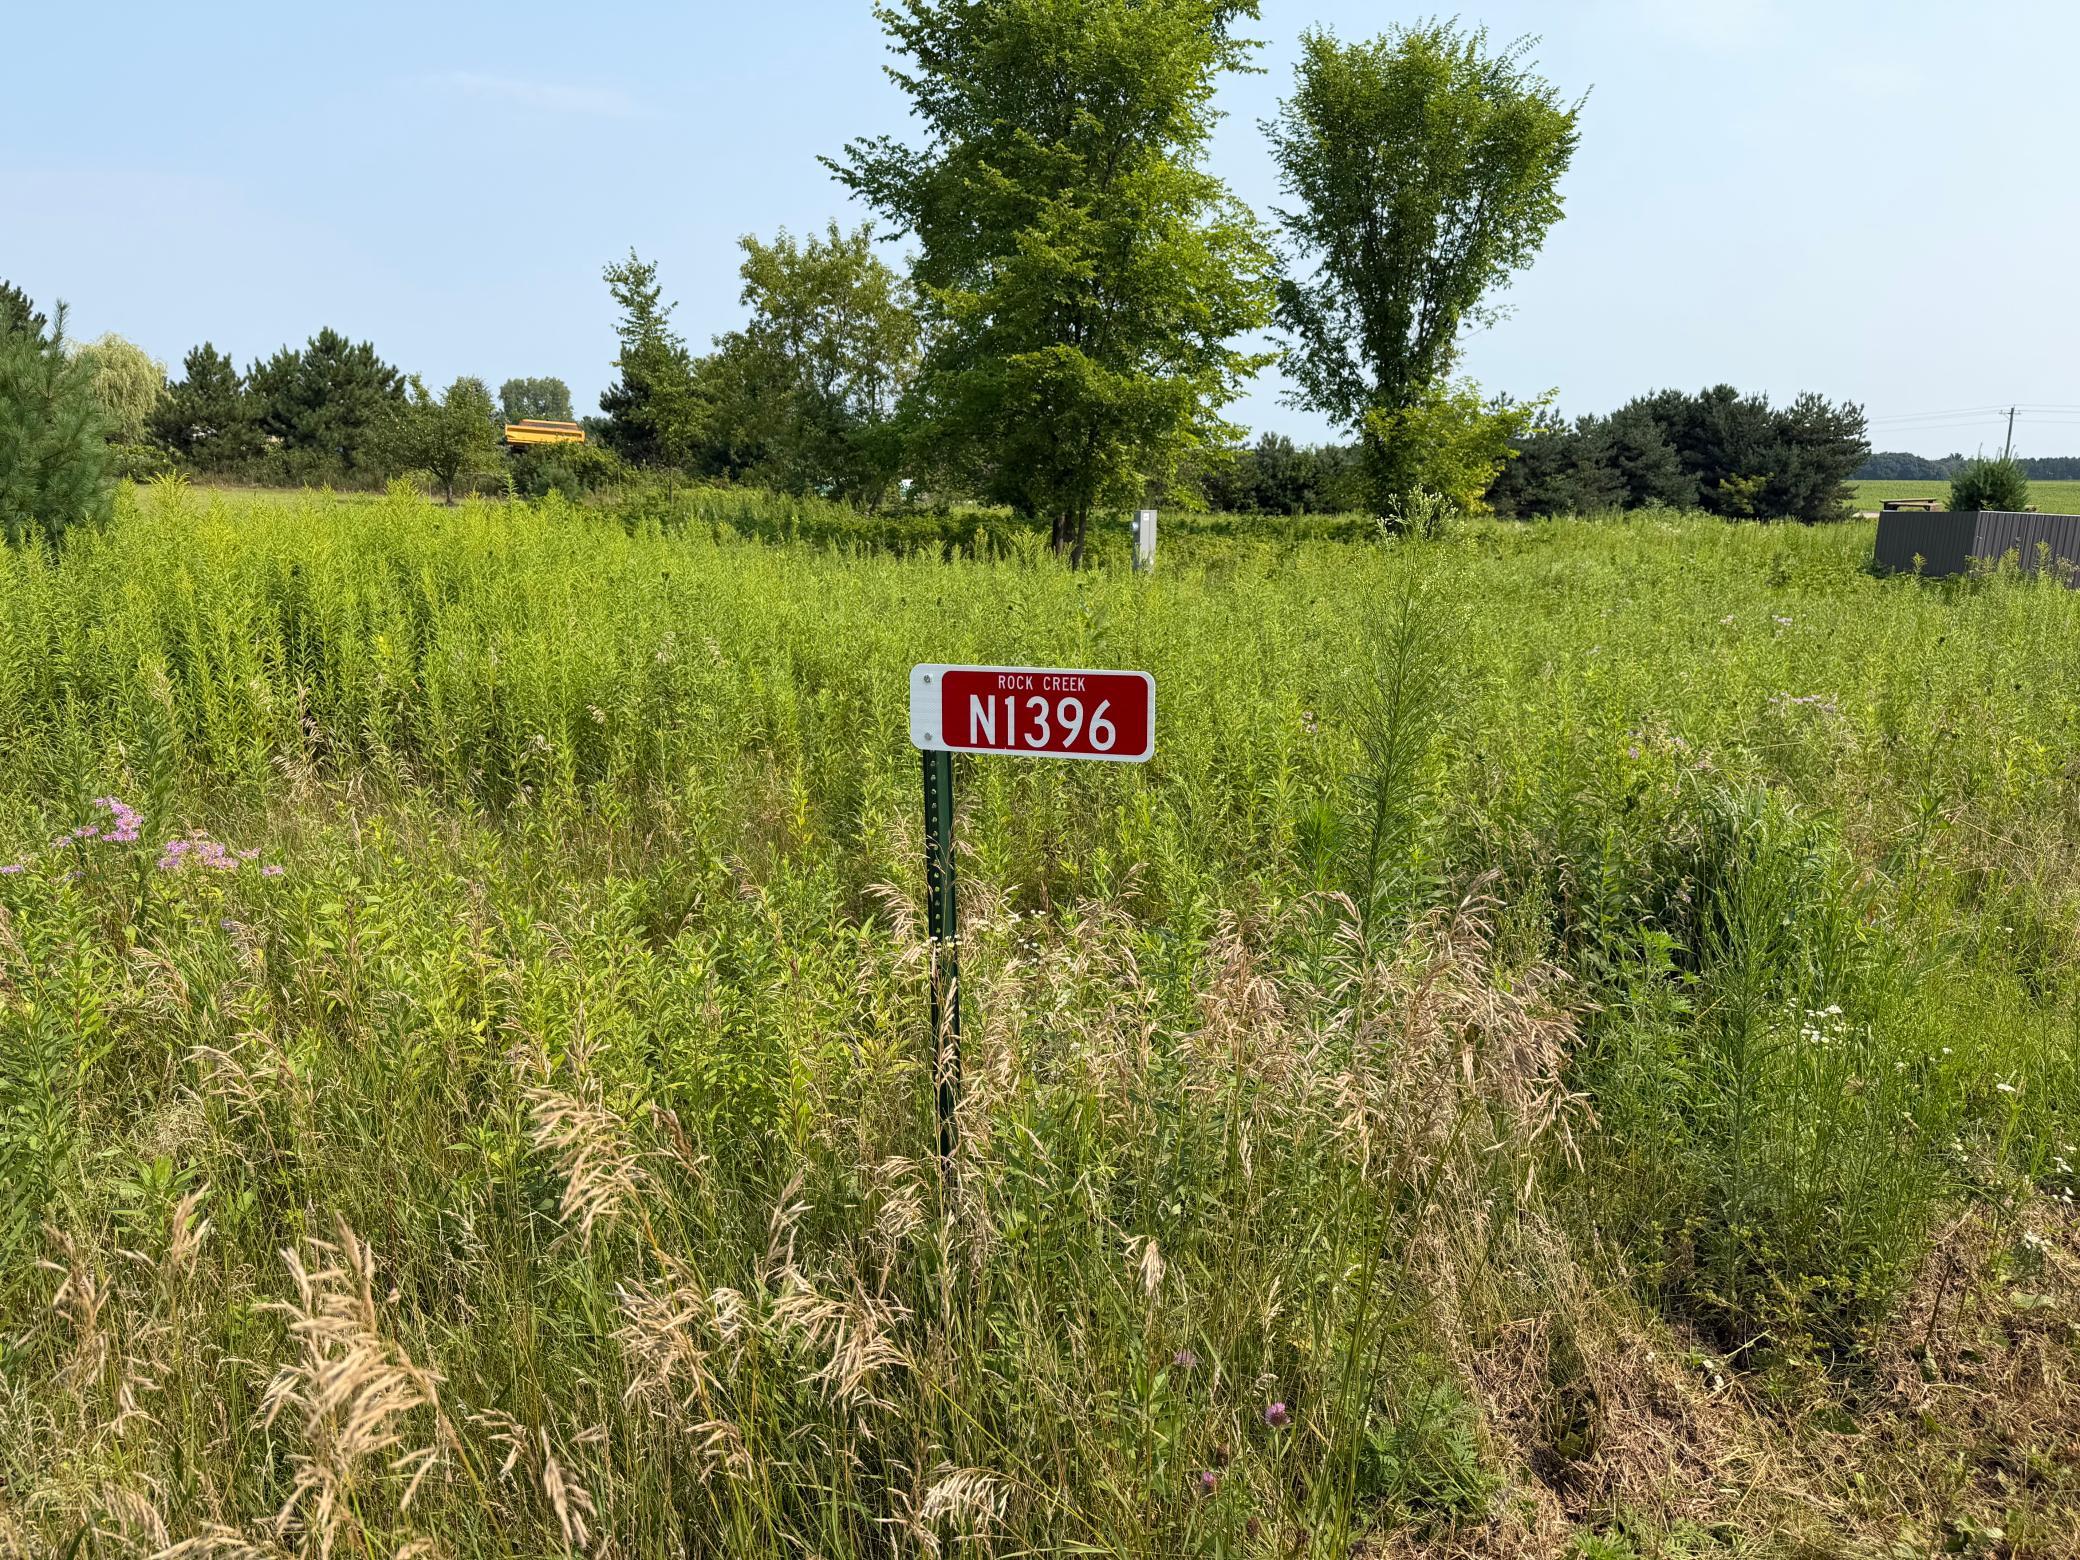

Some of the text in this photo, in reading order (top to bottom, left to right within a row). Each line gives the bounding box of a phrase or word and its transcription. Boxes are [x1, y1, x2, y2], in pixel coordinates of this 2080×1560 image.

[998, 675, 1086, 692] ROCK CREEK
[969, 694, 1116, 751] N1396
